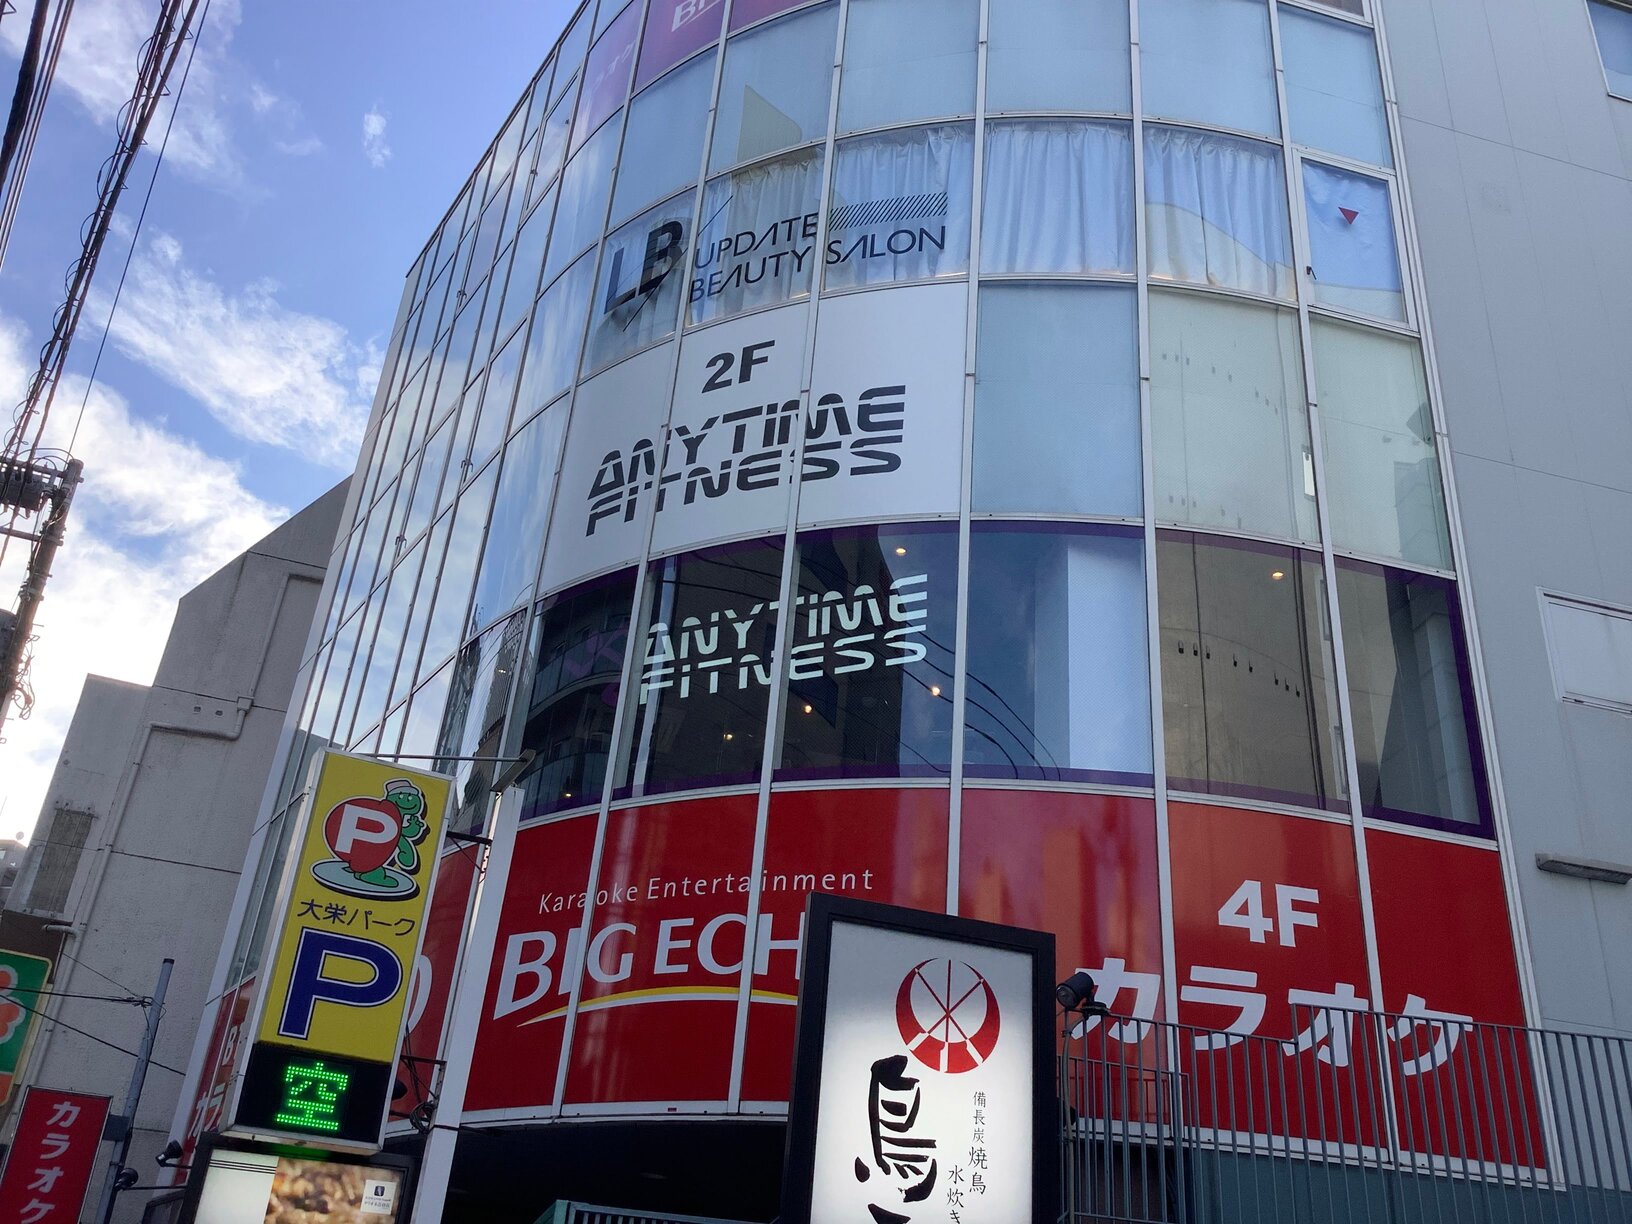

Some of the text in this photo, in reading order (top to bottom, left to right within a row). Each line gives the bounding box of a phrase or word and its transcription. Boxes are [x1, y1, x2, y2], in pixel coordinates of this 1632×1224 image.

[690, 226, 947, 303] BEAUTY SALON
[694, 212, 819, 269] UPDATE
[702, 340, 775, 394] 2F
[587, 385, 906, 500] ANYTIME
[586, 435, 903, 537] FITNESS
[643, 574, 928, 665] ANYTIME
[640, 625, 928, 705] FITNESS
[297, 899, 416, 937] 大栄パーク
[539, 868, 874, 914] Karaoke Entertainment
[1218, 880, 1319, 947] 4F
[277, 926, 404, 1041] P
[493, 921, 637, 1020] BIG
[653, 912, 802, 980] ECH
[1072, 957, 1474, 1076] カラオケ
[276, 1061, 350, 1131] 空
[19, 1101, 81, 1224] カラオケ
[854, 1054, 938, 1224] 鳥
